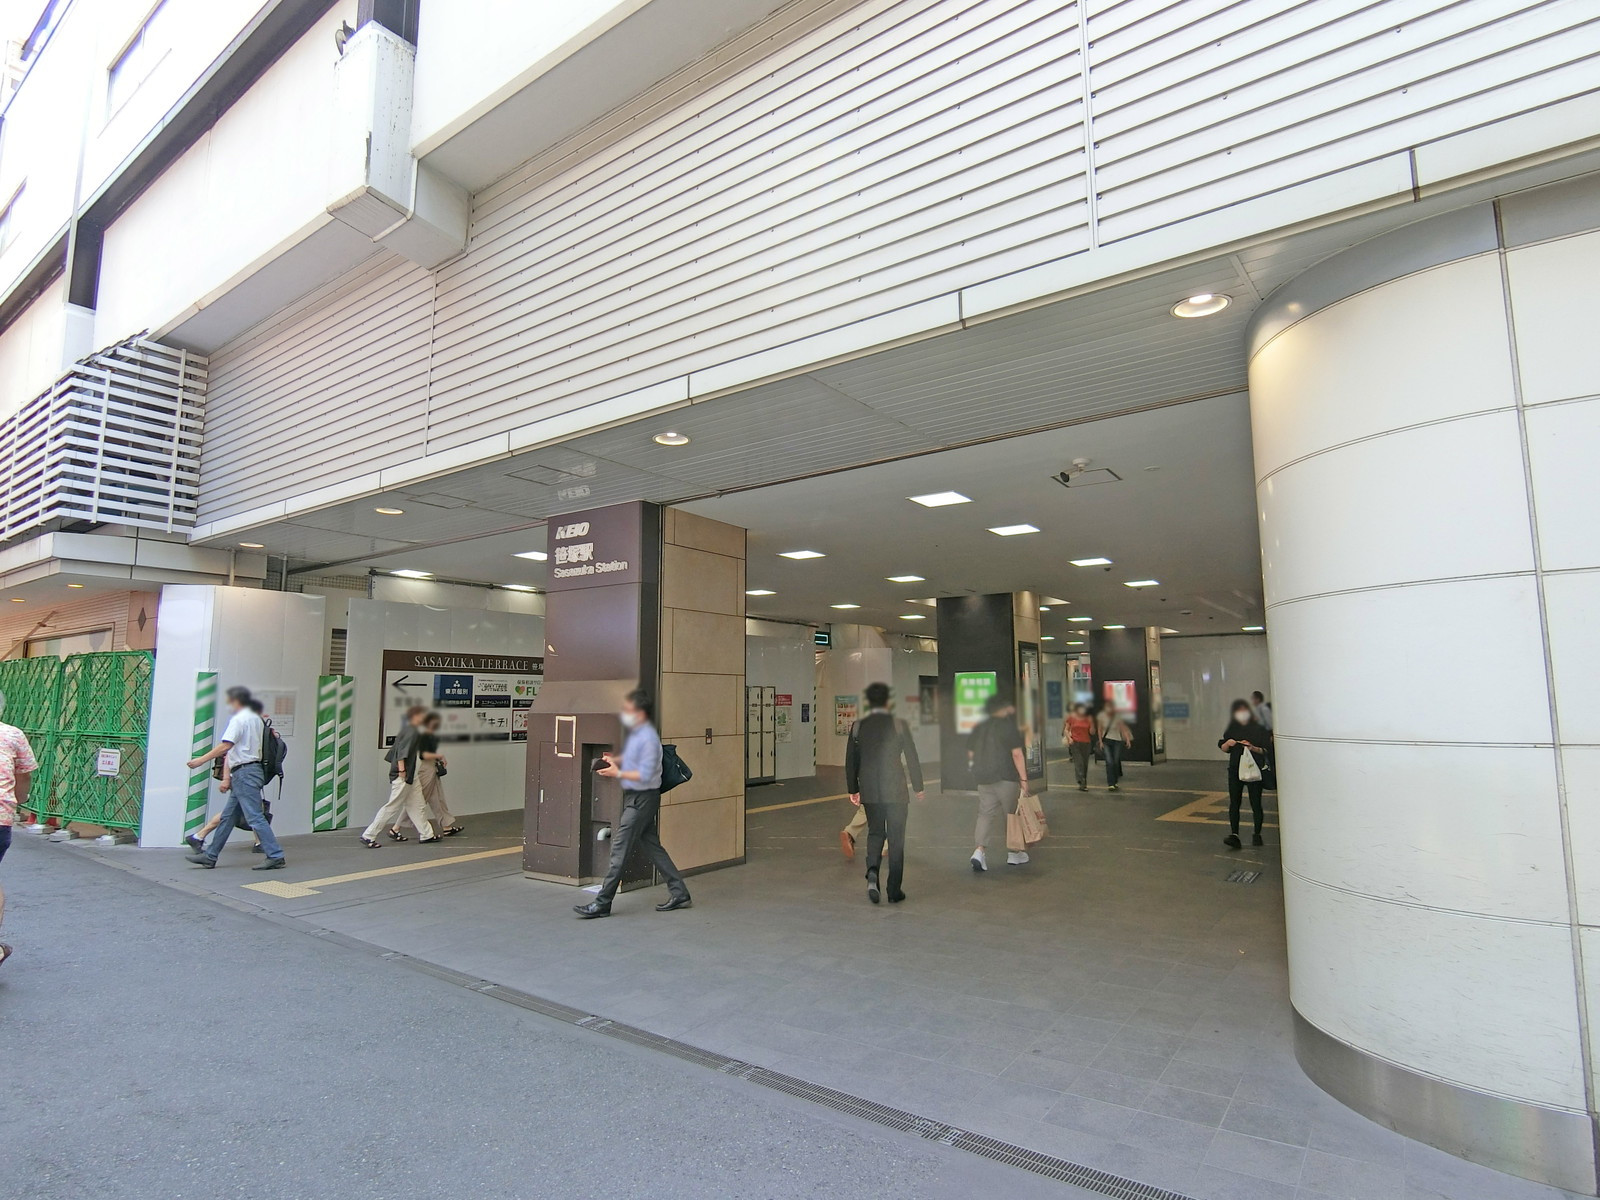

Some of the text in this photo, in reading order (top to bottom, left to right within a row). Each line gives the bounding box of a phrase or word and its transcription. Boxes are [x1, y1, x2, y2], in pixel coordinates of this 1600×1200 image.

[555, 522, 590, 540] KEIO
[554, 543, 594, 565] 笹塚駅
[554, 560, 628, 579] Sasazuka Station
[414, 655, 475, 669] SASAZUKA
[480, 658, 529, 671] TERRACE
